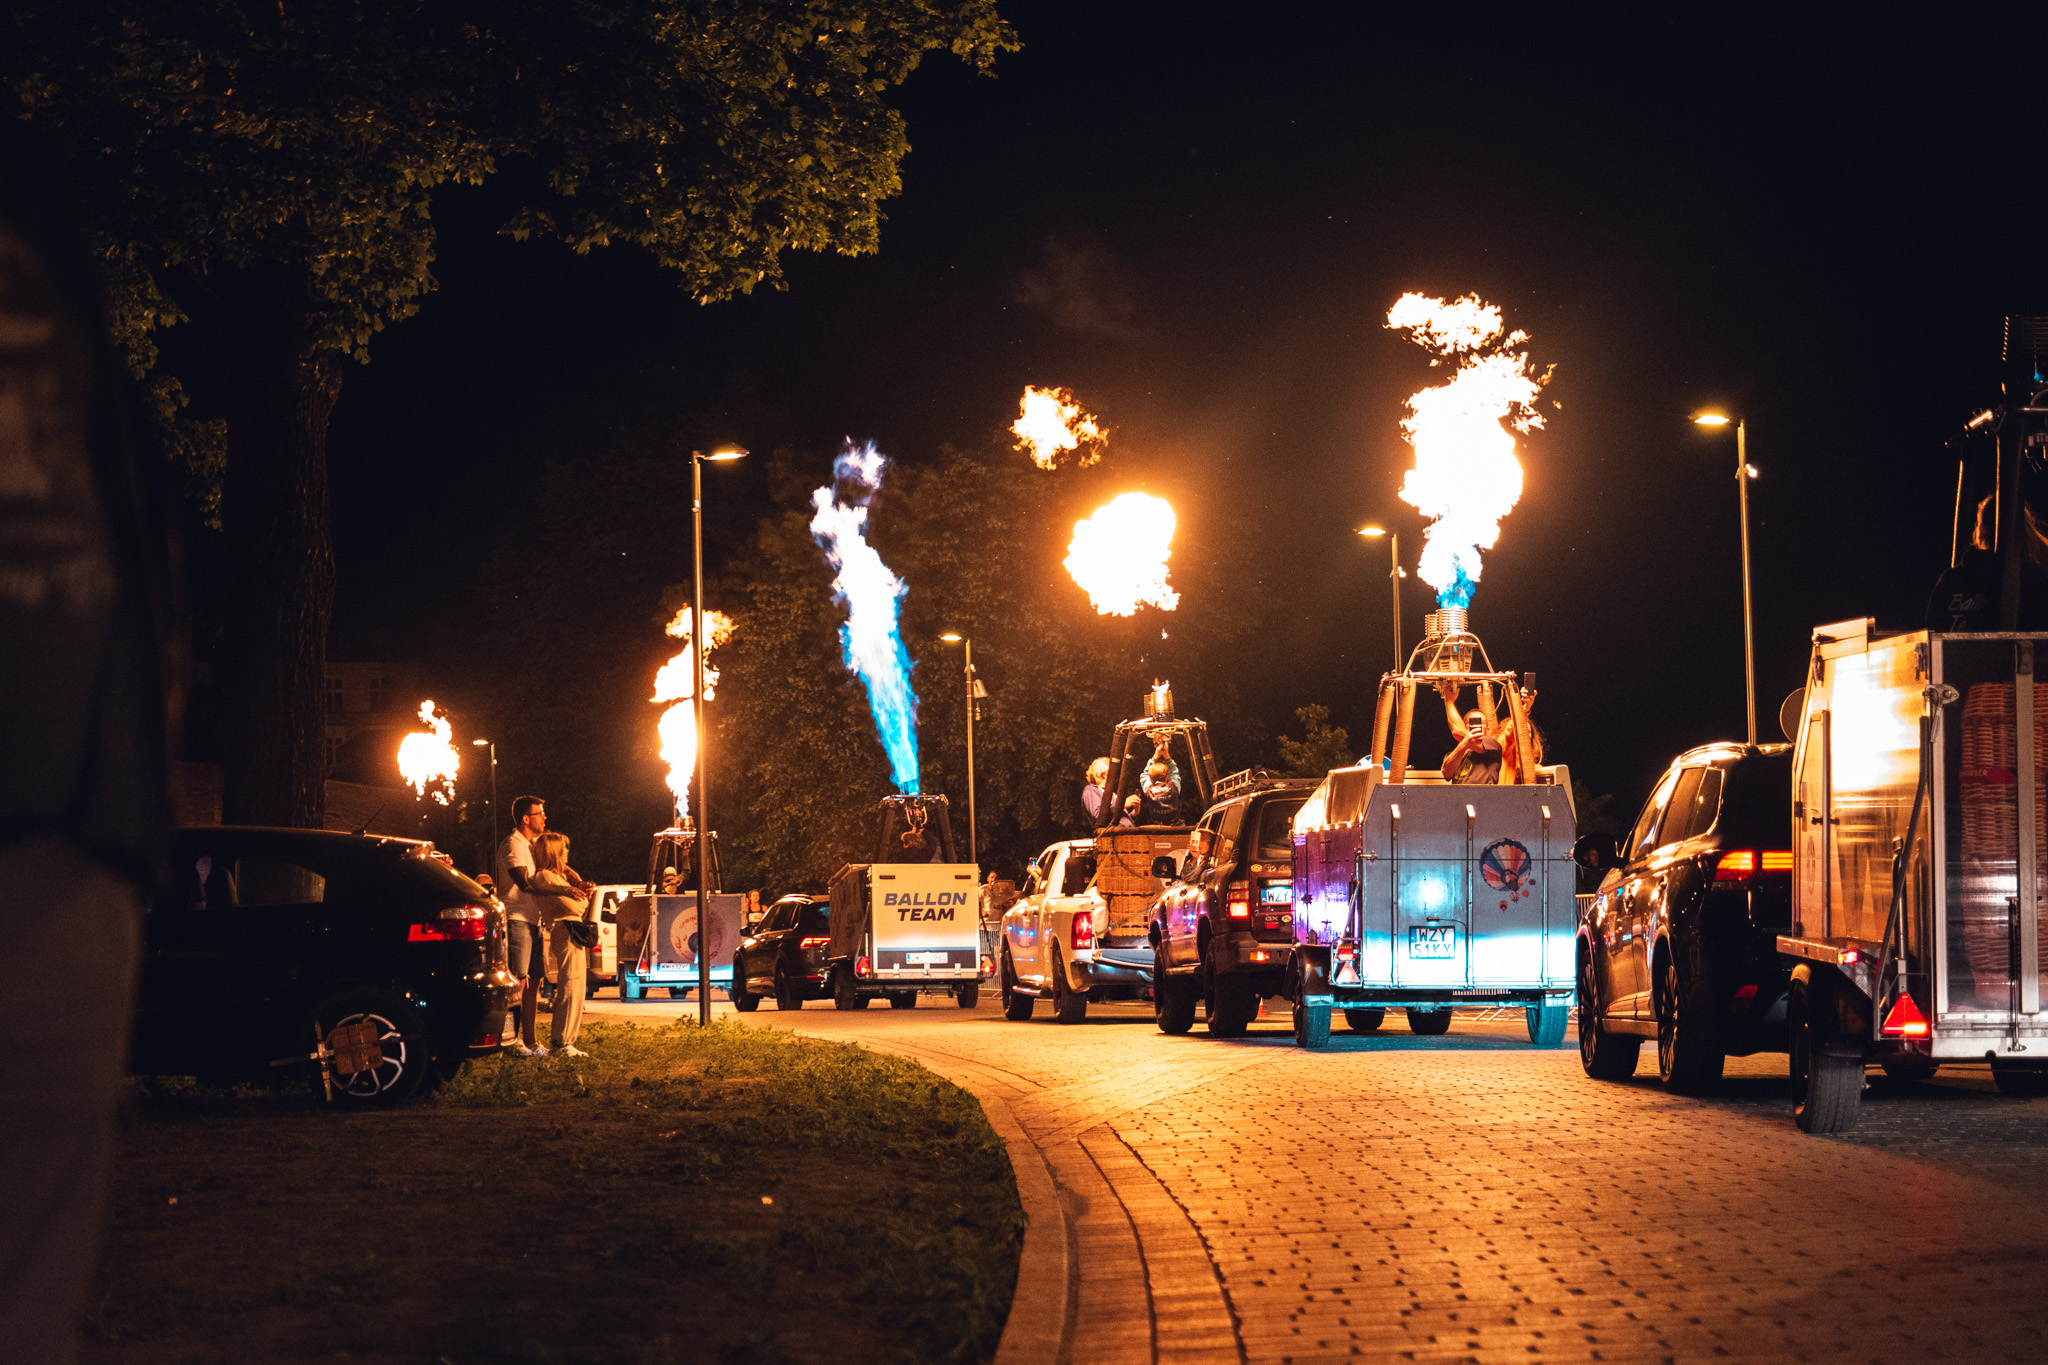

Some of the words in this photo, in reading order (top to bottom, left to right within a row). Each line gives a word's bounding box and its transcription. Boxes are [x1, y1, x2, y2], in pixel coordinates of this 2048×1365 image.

[884, 892, 967, 906] BALLON
[1268, 890, 1289, 902] WZY
[897, 908, 954, 921] TEAM
[1419, 928, 1448, 942] WZY
[1414, 943, 1451, 957] 51KX
